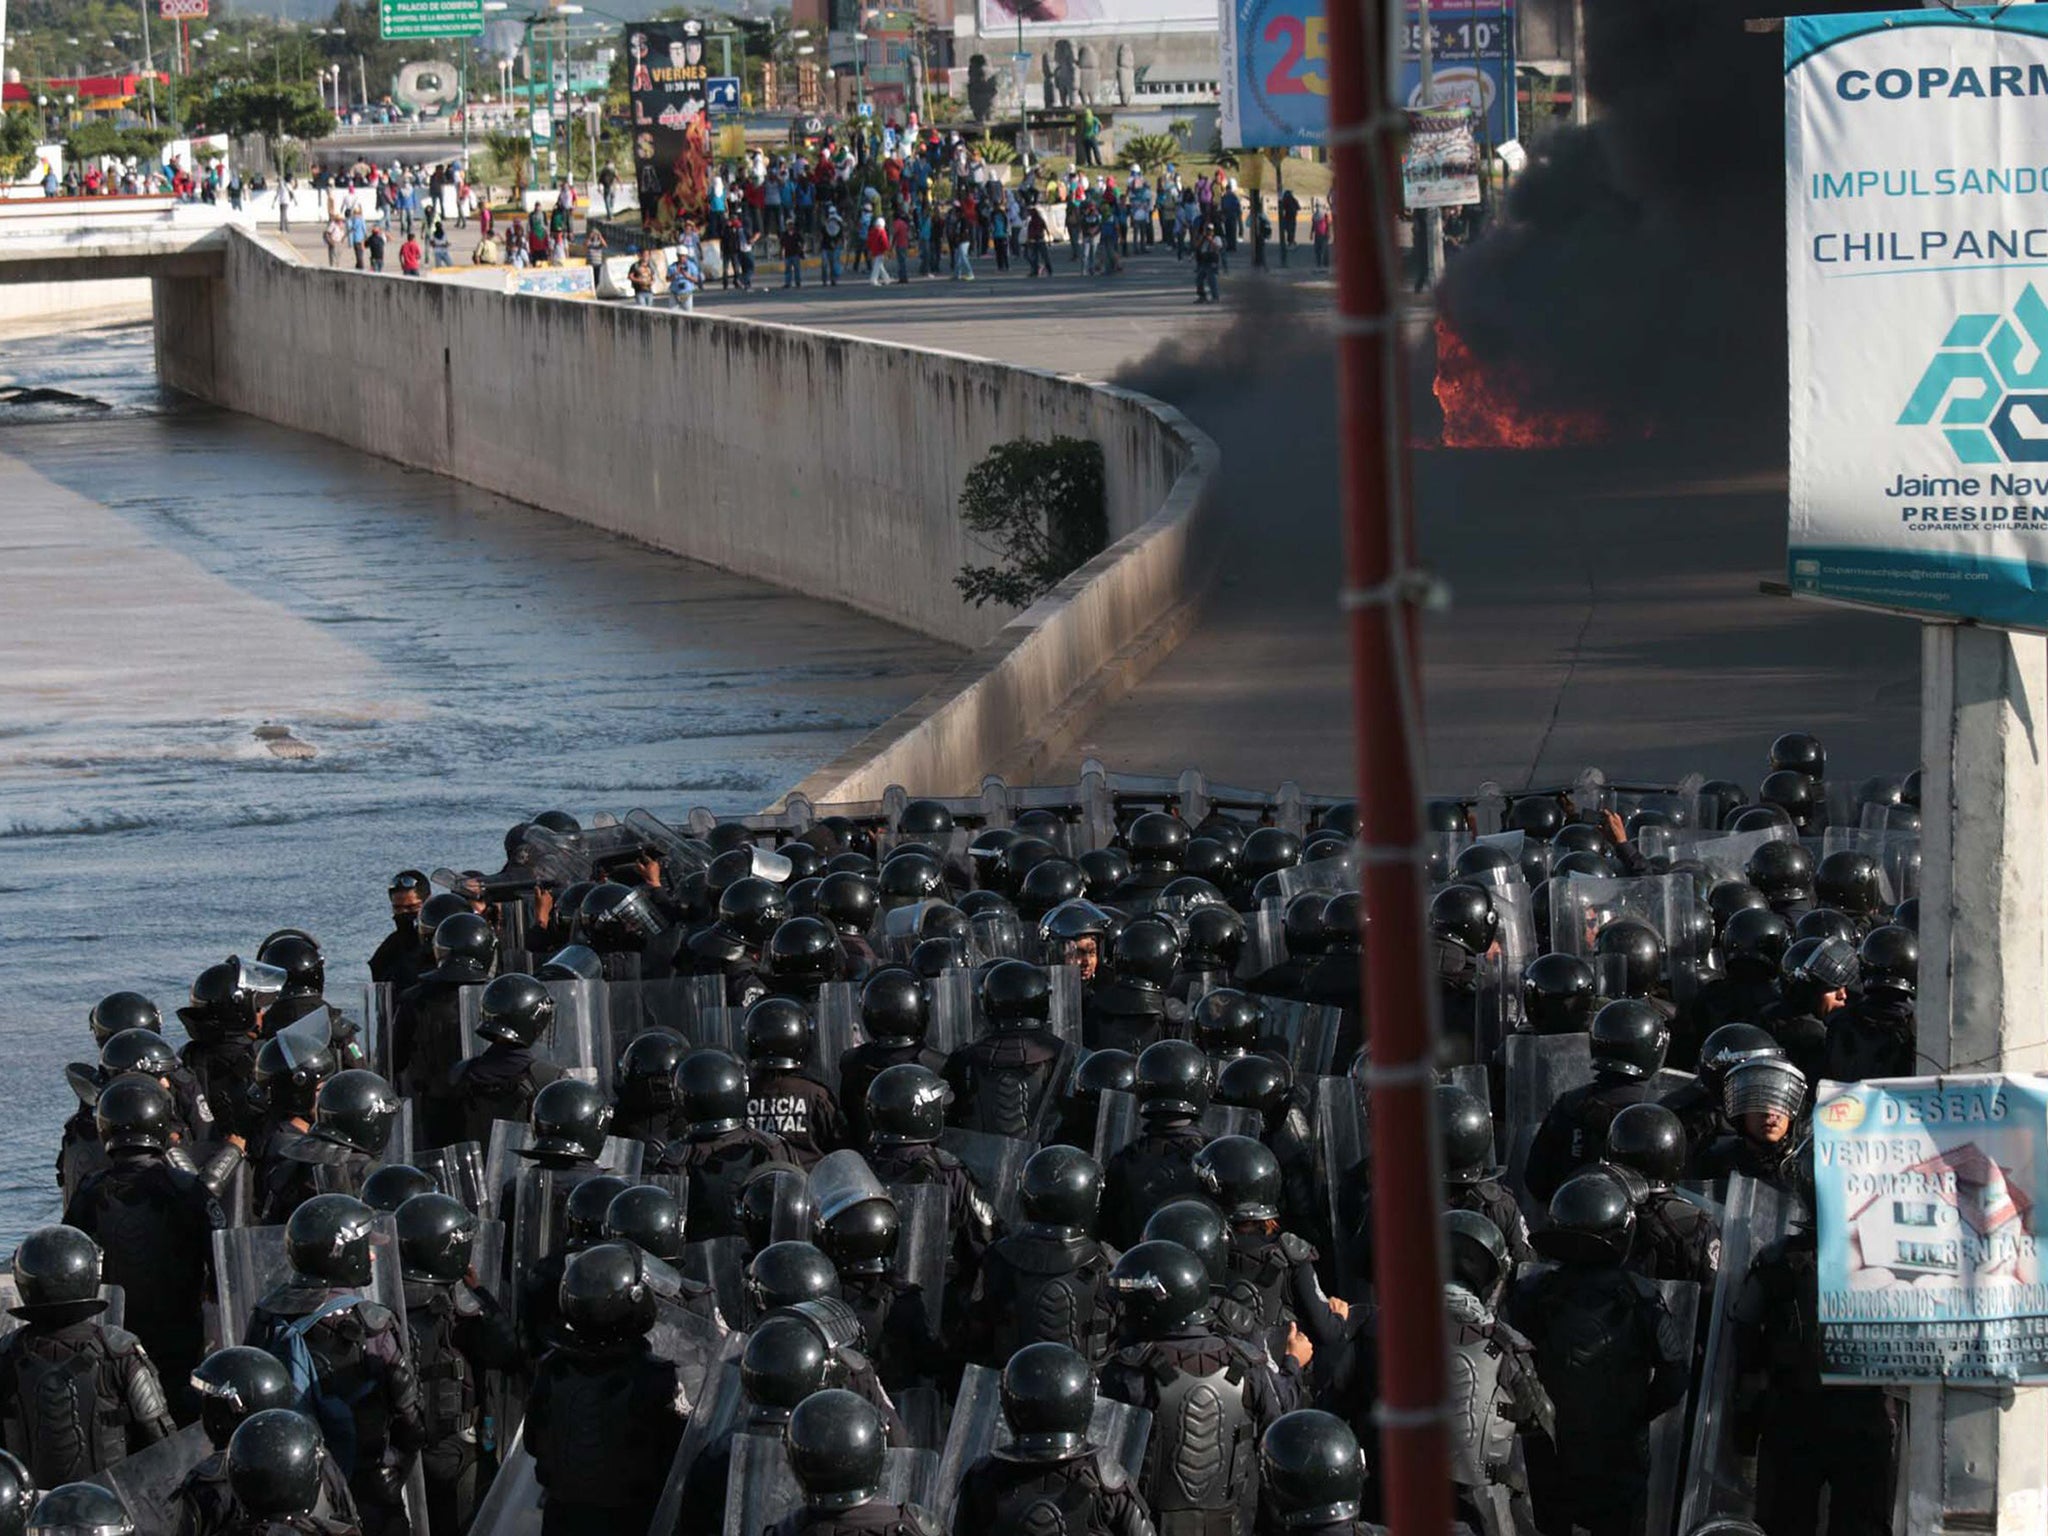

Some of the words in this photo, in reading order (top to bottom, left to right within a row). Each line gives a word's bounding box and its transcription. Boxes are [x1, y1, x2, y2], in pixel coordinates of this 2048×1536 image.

[161, 0, 205, 14] OXXO
[1264, 15, 1329, 96] 25
[652, 66, 707, 82] VIERNES
[1813, 168, 2048, 199] IMPULSAND
[1814, 229, 2048, 262] CHILPANC
[1885, 474, 1980, 497] Jaime
[1902, 506, 2048, 522] PRESIDEN
[1908, 523, 1979, 531] COPARMEX
[747, 1095, 807, 1116] OLICIA
[1881, 1093, 2008, 1125] DESEAS
[746, 1115, 807, 1132] STATAL
[1820, 1138, 1922, 1166] VENDER
[1847, 1170, 1960, 1195] COMPRAR
[1944, 1235, 2037, 1263] RENTAR
[1823, 1290, 1890, 1318] NOSOTROS
[1892, 1288, 1935, 1318] SOMOS
[1825, 1325, 1848, 1340] AV.
[1852, 1324, 1911, 1339] MIGUEL
[1915, 1323, 1979, 1340] ALEMAN
